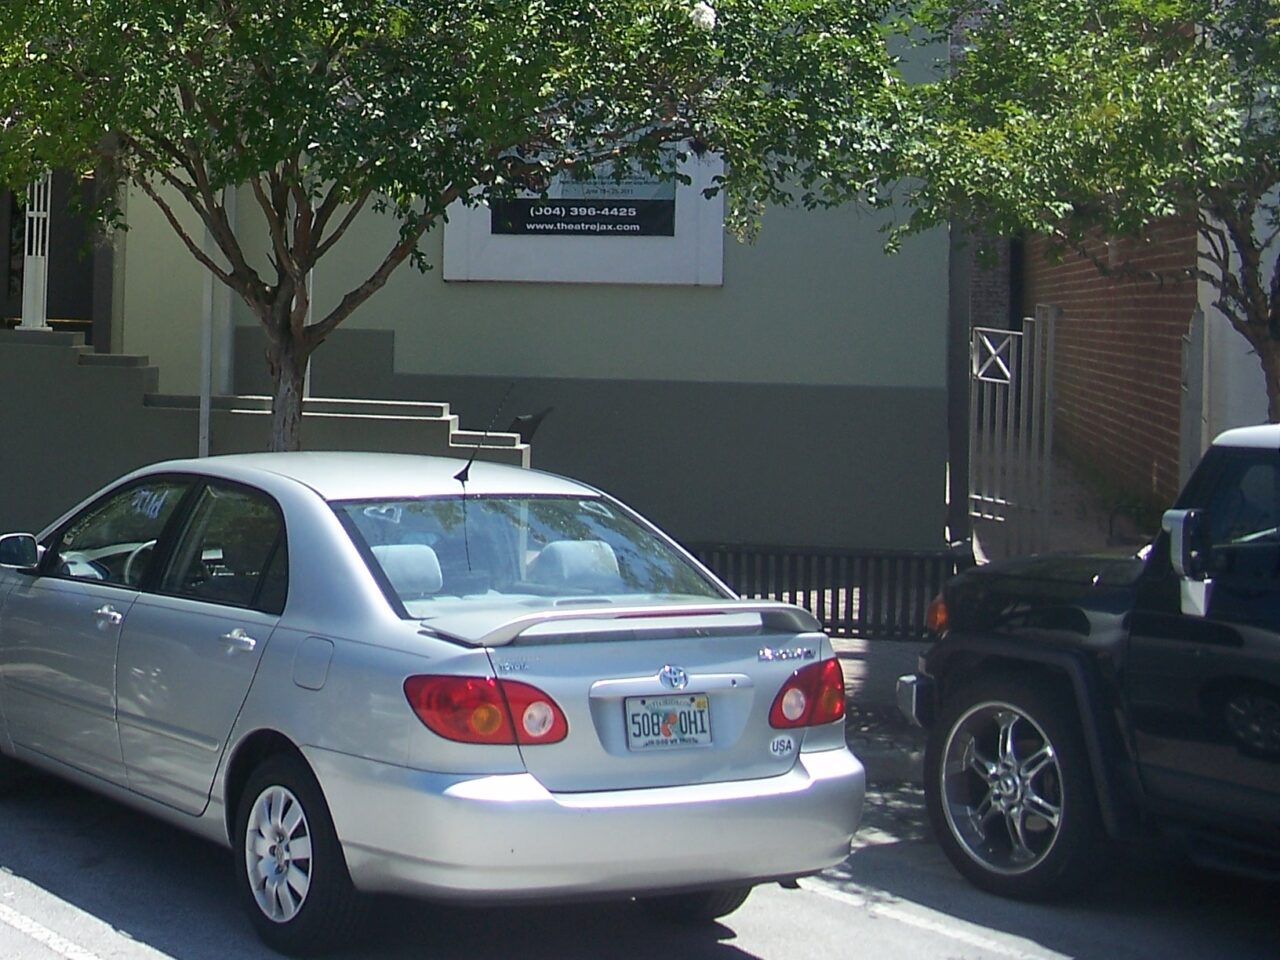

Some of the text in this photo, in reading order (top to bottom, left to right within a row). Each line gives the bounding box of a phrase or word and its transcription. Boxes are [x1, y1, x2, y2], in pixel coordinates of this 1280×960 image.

[570, 207, 637, 217] 396-4425
[526, 222, 640, 232] www.theatrejax.com
[631, 712, 661, 738] 508
[772, 739, 792, 753] USA
